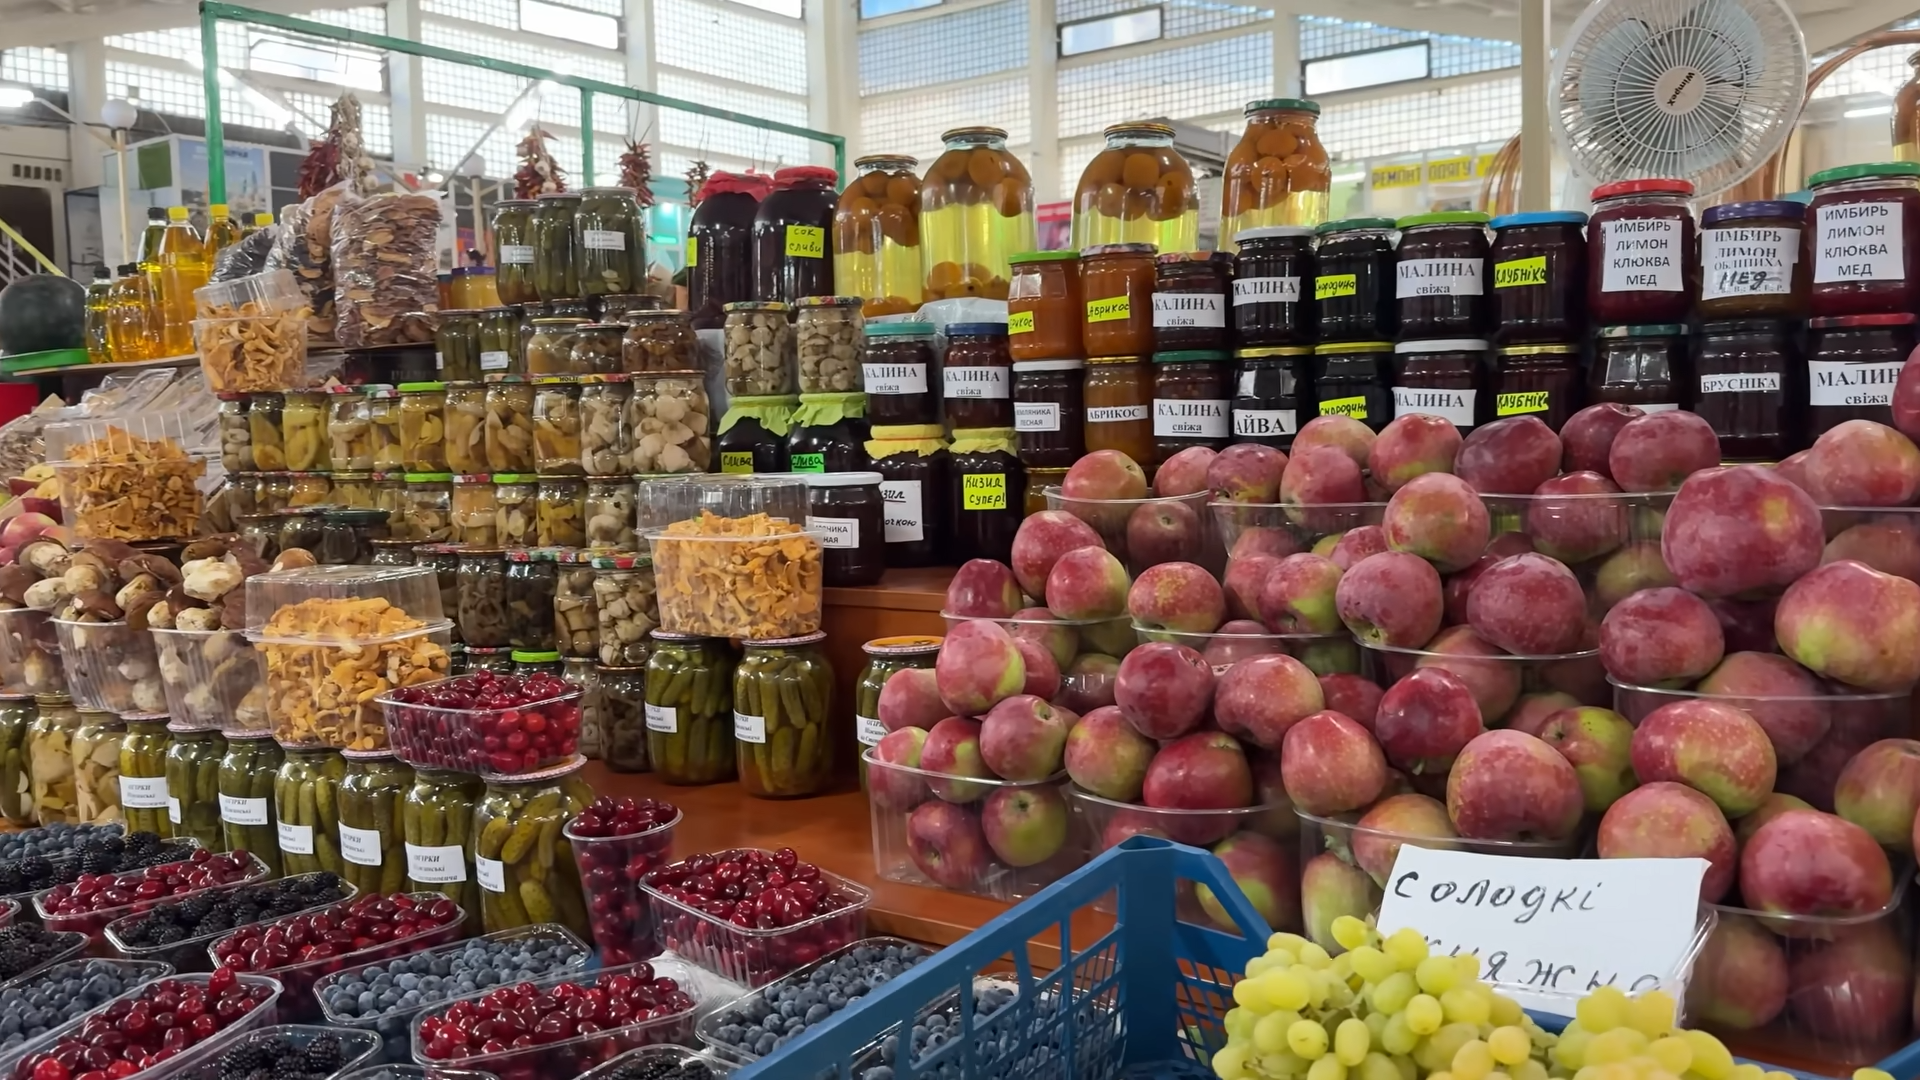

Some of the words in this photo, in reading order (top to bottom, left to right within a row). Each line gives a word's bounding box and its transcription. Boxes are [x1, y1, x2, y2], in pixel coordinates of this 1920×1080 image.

[1825, 205, 1889, 221] ИМБИРЬ
[1614, 221, 1671, 233] ИМБИРЬ
[1827, 225, 1885, 240] ЛИМОН
[1715, 229, 1782, 242] ИМБИРЬ
[1616, 239, 1668, 251] ЛИМОН
[1714, 247, 1777, 259] ЛИМОН
[1825, 244, 1888, 259] КЛЮКВА
[1613, 257, 1670, 269] КЛЮКВА
[1400, 263, 1475, 278] МАЛИНА
[1838, 263, 1873, 277] МЕД
[1626, 274, 1657, 287] МЕД
[1235, 281, 1296, 296] КАЛИНА
[1416, 284, 1450, 294] свіжа
[1155, 298, 1216, 311] КАЛИНА
[1167, 316, 1195, 326] свіжа
[865, 367, 918, 379] КАЛИНА
[945, 370, 1000, 382] КАЛИНА
[1817, 367, 1901, 387] МАЛИН
[875, 384, 900, 392] свіжа
[1703, 376, 1778, 391] БРУСНІКА
[956, 387, 982, 395] свіжа
[1845, 393, 1888, 404] свіжа
[1090, 408, 1140, 419] АБРИКОС
[1158, 404, 1222, 417] КАЛИНА
[1172, 423, 1202, 432] свіжа
[1236, 415, 1286, 433] АЙВА
